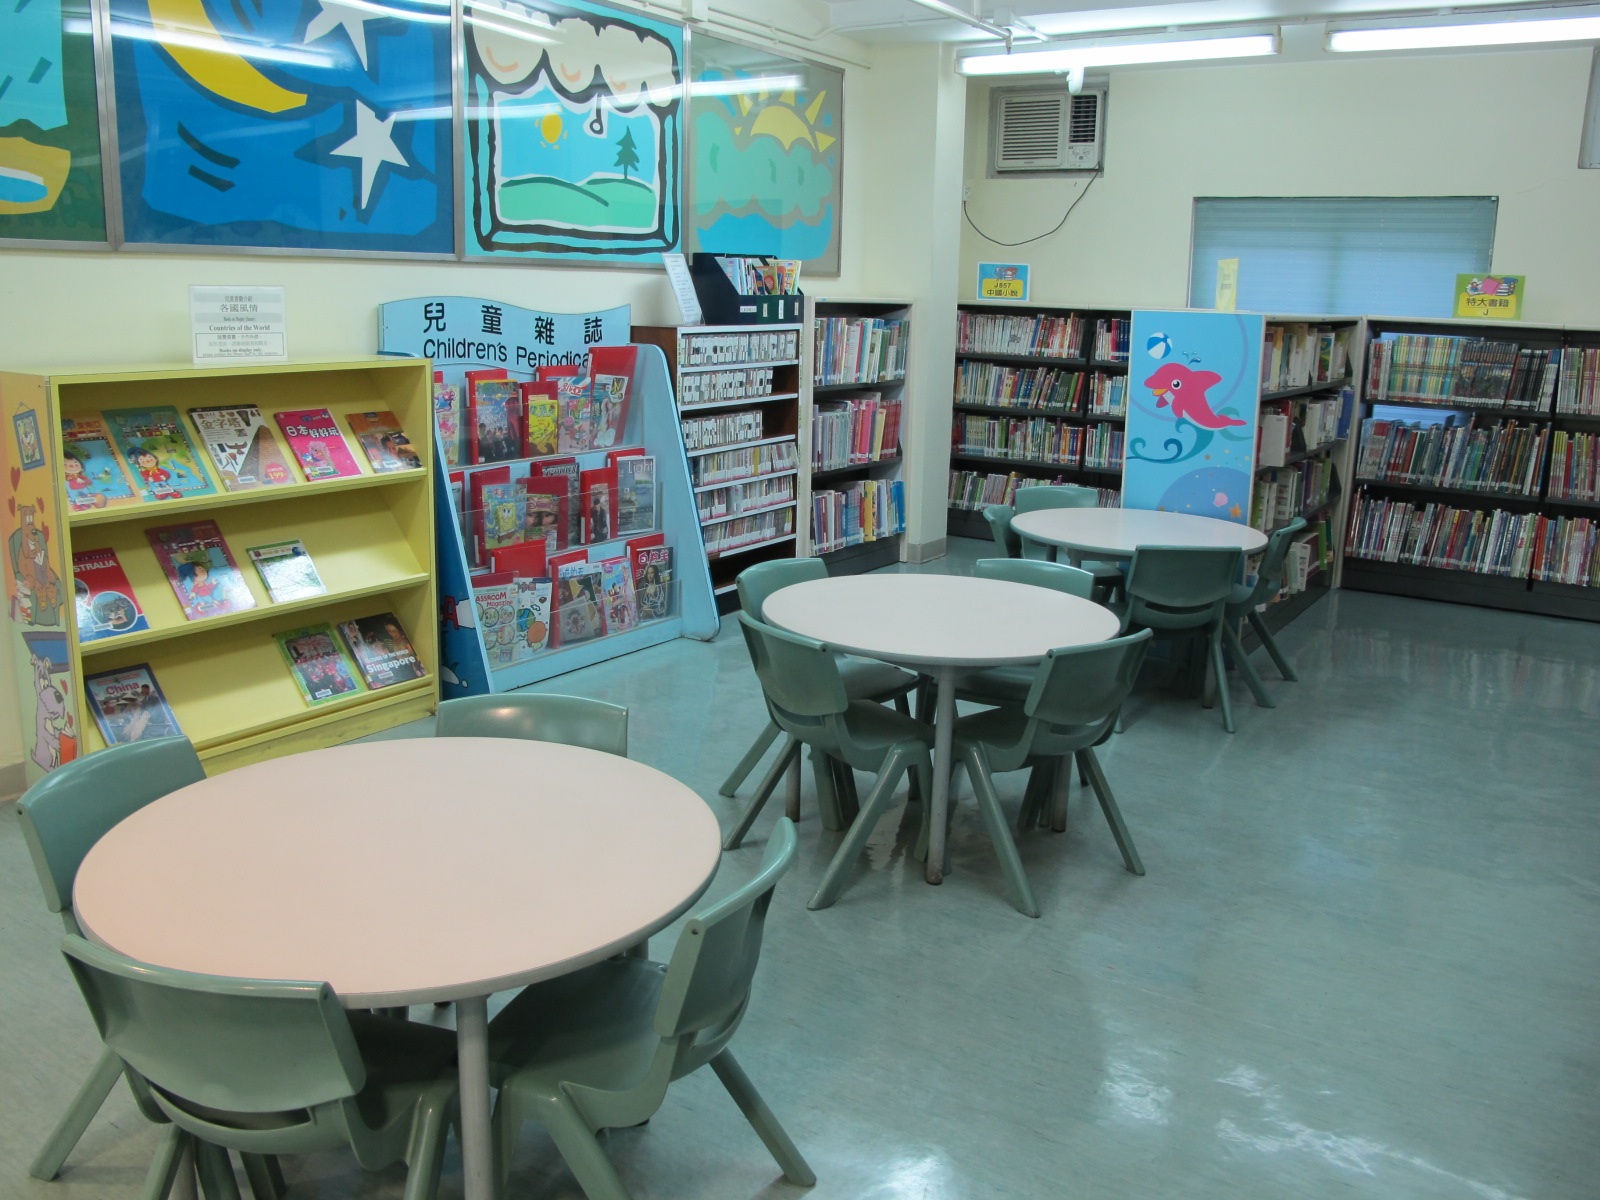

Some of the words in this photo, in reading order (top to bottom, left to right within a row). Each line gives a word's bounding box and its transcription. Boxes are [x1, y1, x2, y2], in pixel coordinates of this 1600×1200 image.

[220, 303, 258, 313] 各國風情
[1466, 298, 1509, 307] 特大書籍
[423, 302, 603, 346] 兒童雜誌
[423, 338, 508, 363] Children's
[516, 346, 591, 369] Periodica
[200, 417, 242, 430] 金字塔
[286, 424, 340, 439] 日本好好玩
[73, 559, 118, 573] STRALIA
[475, 591, 507, 603] ASSROOM
[366, 655, 416, 673] Singapore
[105, 682, 140, 695] China
